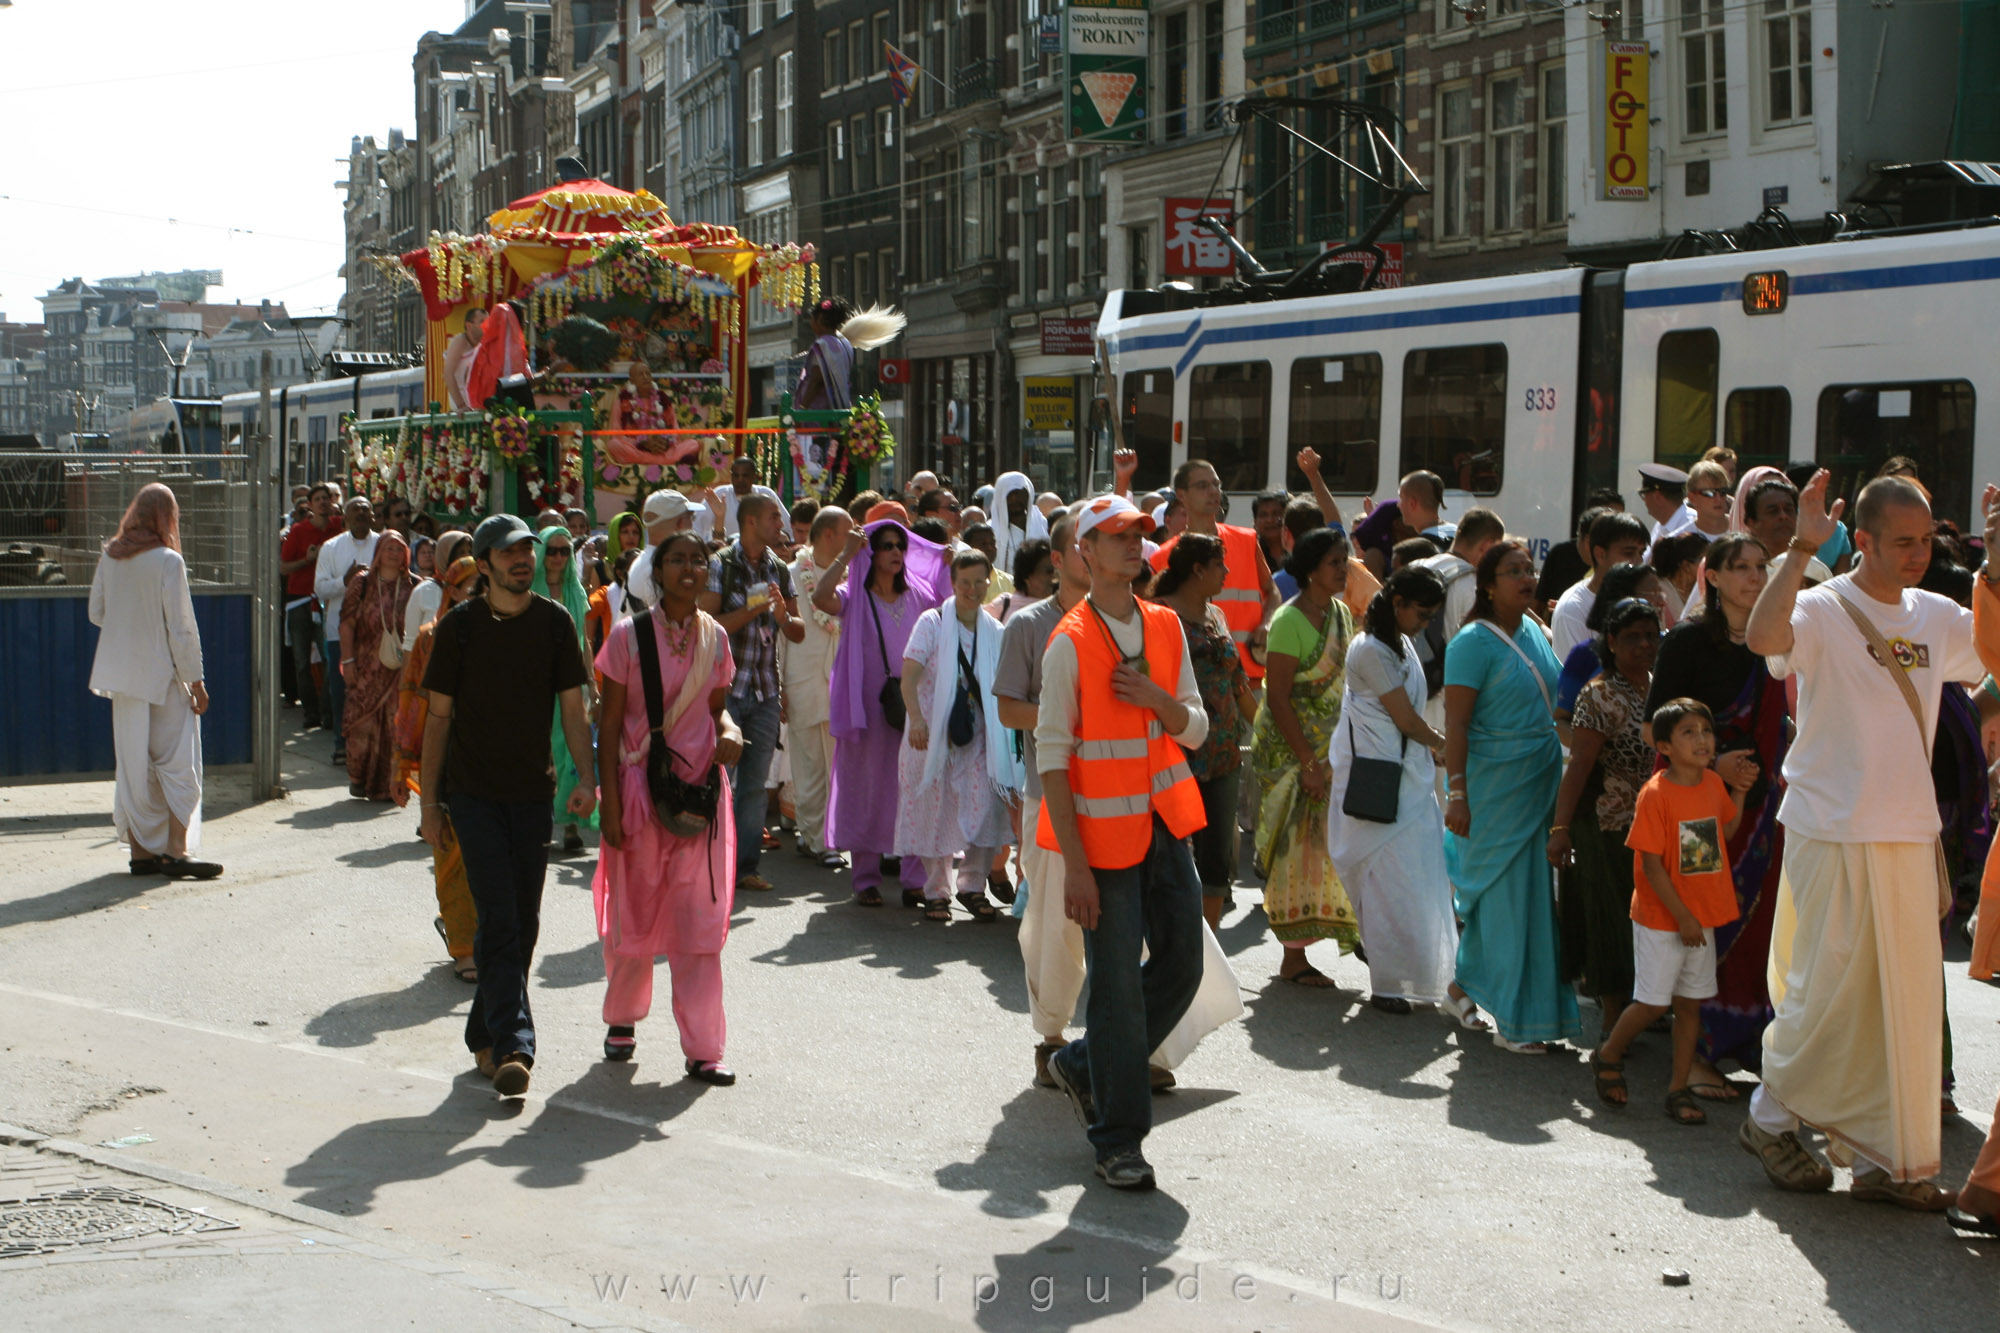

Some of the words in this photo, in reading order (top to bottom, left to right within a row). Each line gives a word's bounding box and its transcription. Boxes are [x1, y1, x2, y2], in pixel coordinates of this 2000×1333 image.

[1072, 13, 1144, 25] snookercentre
[1610, 43, 1645, 53] Canon
[1609, 56, 1636, 184] FOTO
[1610, 186, 1644, 196] Canon
[1044, 326, 1090, 335] POPULAR
[1026, 386, 1074, 398] MASSAGE
[1525, 388, 1556, 411] 833
[1030, 403, 1067, 413] YELLOW
[1035, 414, 1063, 424] RIVER
[1527, 538, 1551, 560] VB
